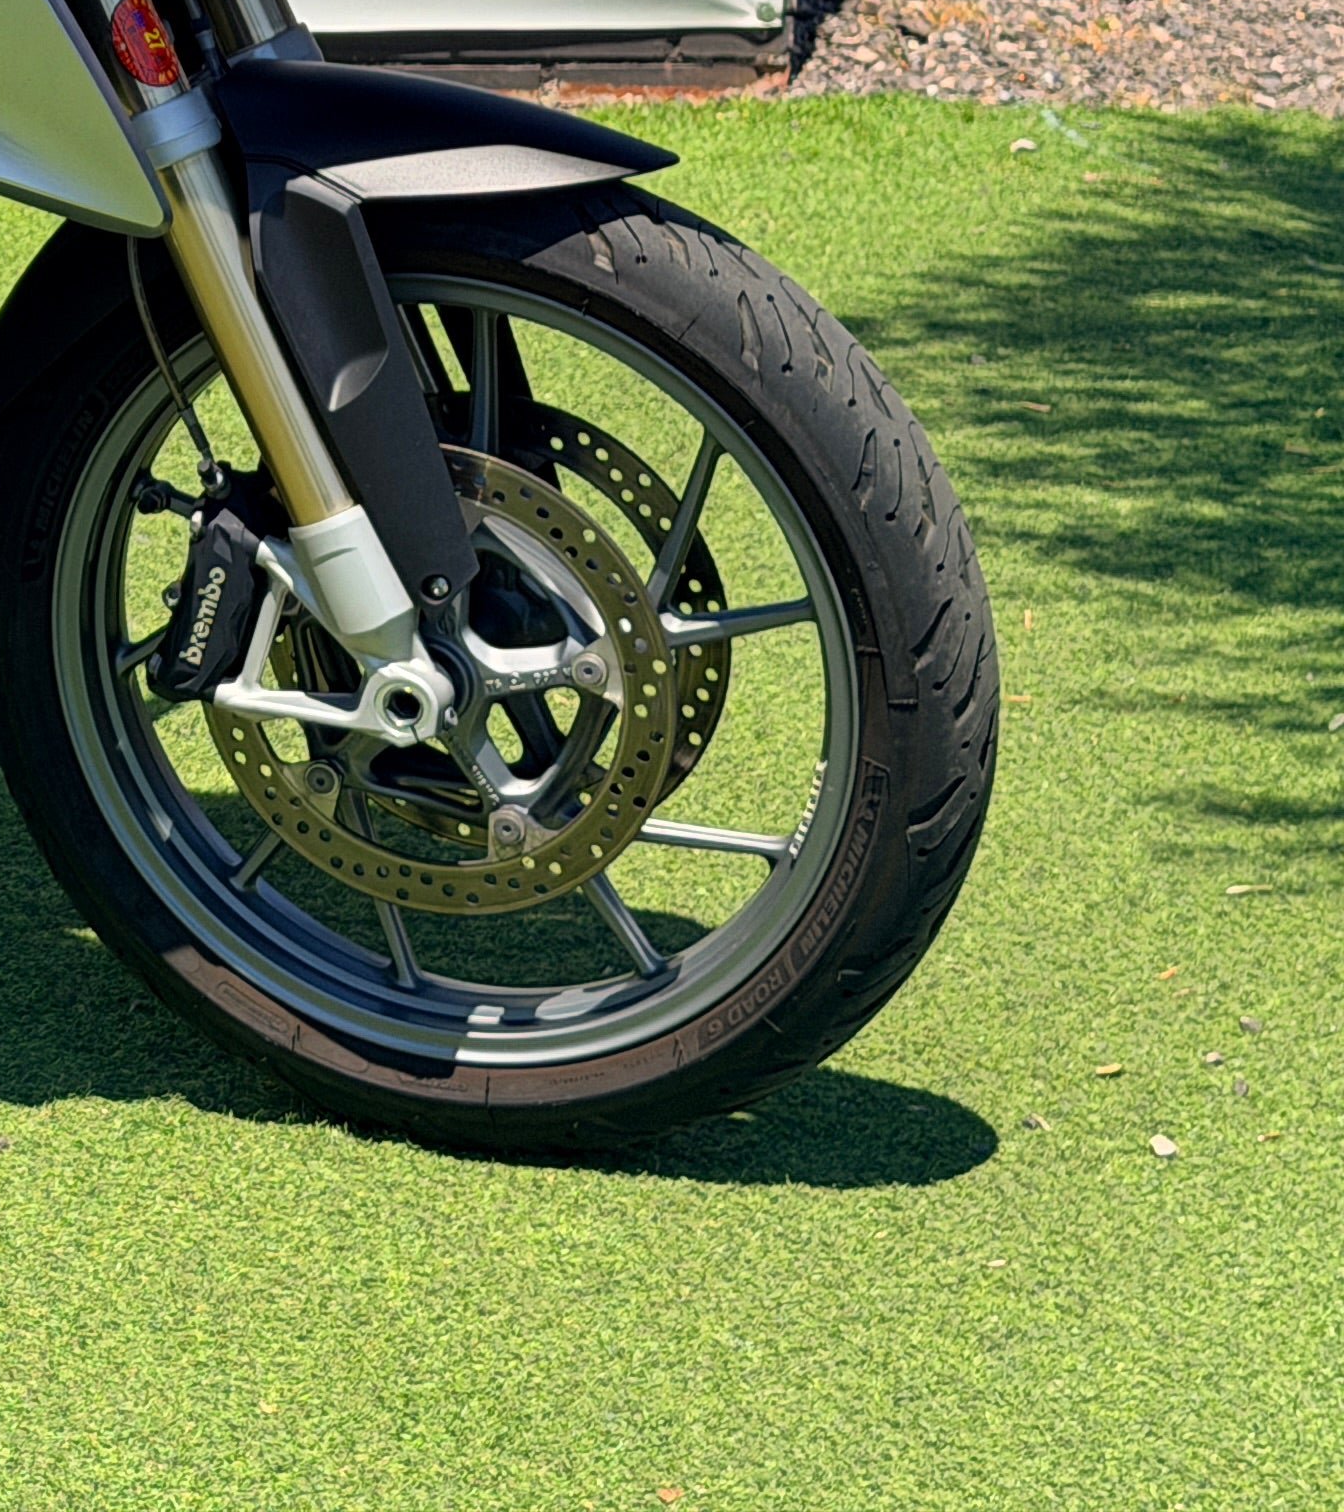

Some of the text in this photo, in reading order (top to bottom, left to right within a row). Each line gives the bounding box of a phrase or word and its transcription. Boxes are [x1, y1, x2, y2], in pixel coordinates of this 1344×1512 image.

[178, 566, 226, 666] brembo
[798, 823, 871, 957] MICHELIN
[727, 968, 787, 1028] ROAD
